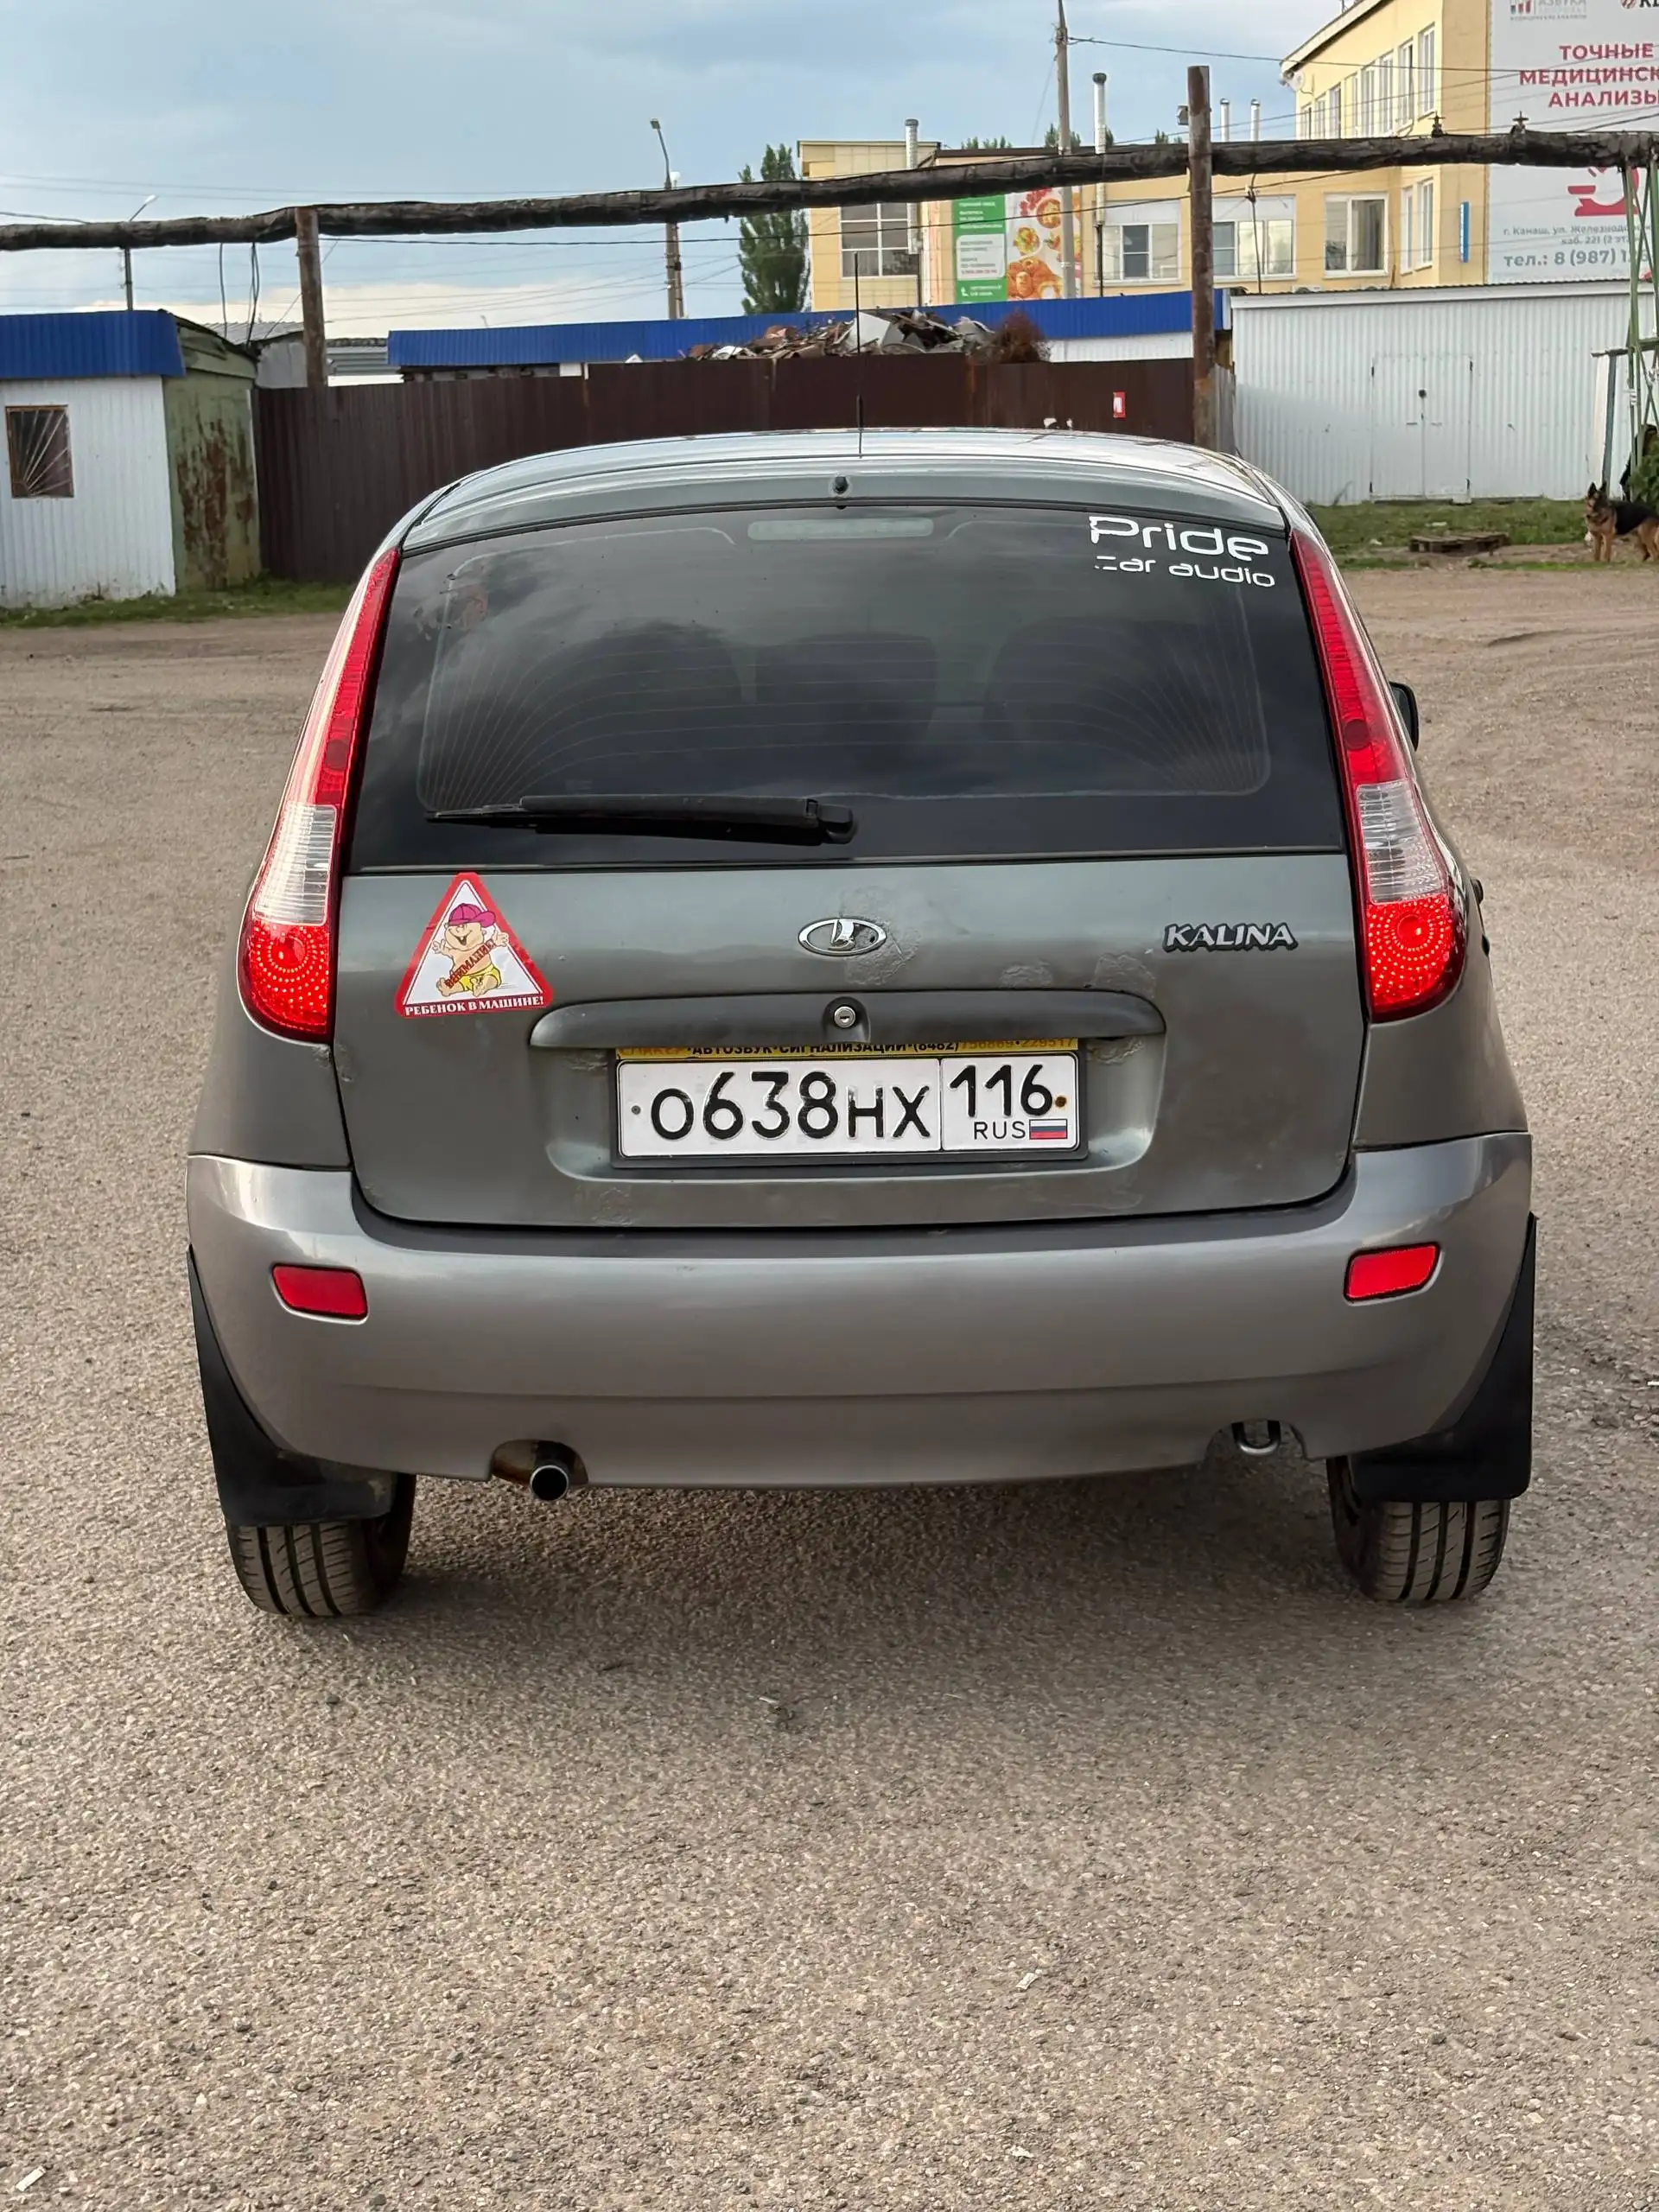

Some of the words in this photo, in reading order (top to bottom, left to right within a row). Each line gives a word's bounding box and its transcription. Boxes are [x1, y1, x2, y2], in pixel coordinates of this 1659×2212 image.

[1559, 43, 1654, 60] ТОЧНЫЕ
[1503, 254, 1548, 267] тел.:
[1554, 251, 1566, 265] 8
[1570, 247, 1616, 267] (987)
[1088, 515, 1269, 562] Pride
[1168, 563, 1275, 588] audio
[1164, 923, 1297, 950] KALINA
[405, 1001, 467, 1016] РЕБЕНОК
[468, 1001, 479, 1011] В
[479, 995, 545, 1011] МАШИНЕ!
[950, 1064, 1053, 1118] 116
[973, 1120, 1027, 1141] RUS
